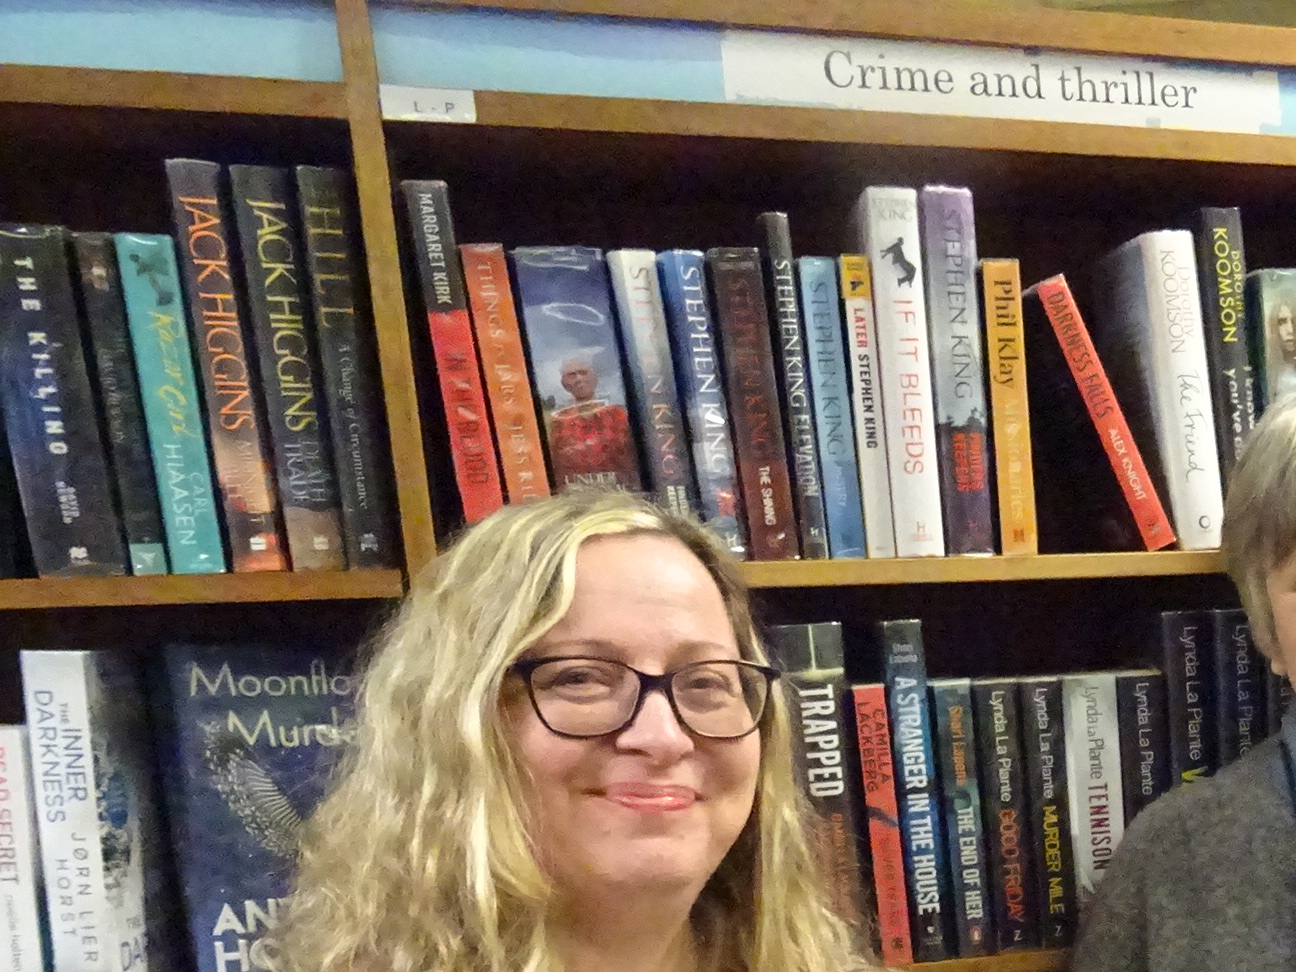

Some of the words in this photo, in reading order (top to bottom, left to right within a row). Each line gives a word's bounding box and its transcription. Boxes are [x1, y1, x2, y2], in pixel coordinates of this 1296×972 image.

[823, 49, 955, 95] Crime
[969, 63, 1045, 100] and
[1058, 66, 1198, 109] thriller
[178, 197, 231, 282] JACK
[245, 198, 297, 286] JACK
[418, 192, 444, 266] MARGARET
[431, 269, 453, 305] KIRK
[942, 208, 968, 324] STEPHEN
[13, 256, 42, 311] THE
[307, 206, 355, 328] HILL
[1213, 227, 1238, 343] KOOMSON
[774, 259, 801, 352] STEPHEN
[853, 307, 868, 349] LATER
[892, 299, 917, 323] IF
[994, 279, 1017, 327] Phil
[1158, 249, 1187, 354] KOOMSON
[198, 292, 255, 431] HIGGINS
[809, 281, 840, 389] STEPHEN
[898, 338, 919, 359] IT
[994, 336, 1021, 388] Klay
[266, 294, 319, 431] HIGGINS
[679, 266, 718, 393] STEPHEN
[700, 403, 729, 474] KING
[786, 353, 807, 407] KING
[858, 354, 875, 413] STEPHEN
[951, 334, 973, 400] KING
[1176, 371, 1200, 407] The
[650, 405, 681, 477] KING
[822, 395, 847, 456] KING
[864, 416, 878, 449] KING
[899, 373, 925, 476] BLEEDS
[1178, 409, 1205, 482] Friend
[792, 413, 818, 496] ELEVATION
[1106, 427, 1127, 455] ALEX
[1121, 456, 1147, 501] KNIGHT
[1180, 626, 1198, 678] Lynda
[1232, 625, 1249, 677] Lynda
[894, 677, 918, 690] A
[1033, 688, 1048, 731] Lynda
[1133, 683, 1154, 726] Lynda
[1186, 682, 1199, 704] La
[1237, 680, 1250, 702] La
[988, 691, 1008, 732] Lynda
[1138, 728, 1151, 748] La
[1187, 707, 1203, 761] Plante
[34, 690, 67, 823] DARKNESS
[62, 728, 89, 802] INNER
[800, 684, 845, 797] TRAPPED
[872, 708, 890, 785] CAMILLA
[897, 692, 929, 790] STRANGER
[996, 736, 1008, 755] La
[1039, 733, 1053, 752] La
[1088, 739, 1108, 780] Plante
[999, 757, 1013, 803] Plante
[1042, 755, 1055, 800] Plante
[1139, 750, 1155, 796] Plante
[906, 793, 930, 814] IN
[957, 806, 976, 834] THE
[1088, 782, 1112, 871] TENNISON
[909, 816, 936, 851] THE
[958, 836, 978, 866] END
[1042, 805, 1063, 873] MURDER
[71, 832, 93, 896] JØRN
[913, 853, 941, 917] HOUSE
[962, 868, 981, 886] OF
[55, 858, 77, 937] HORST
[964, 890, 984, 921] HER
[1048, 876, 1065, 915] MILE
[79, 911, 99, 963] LIER
